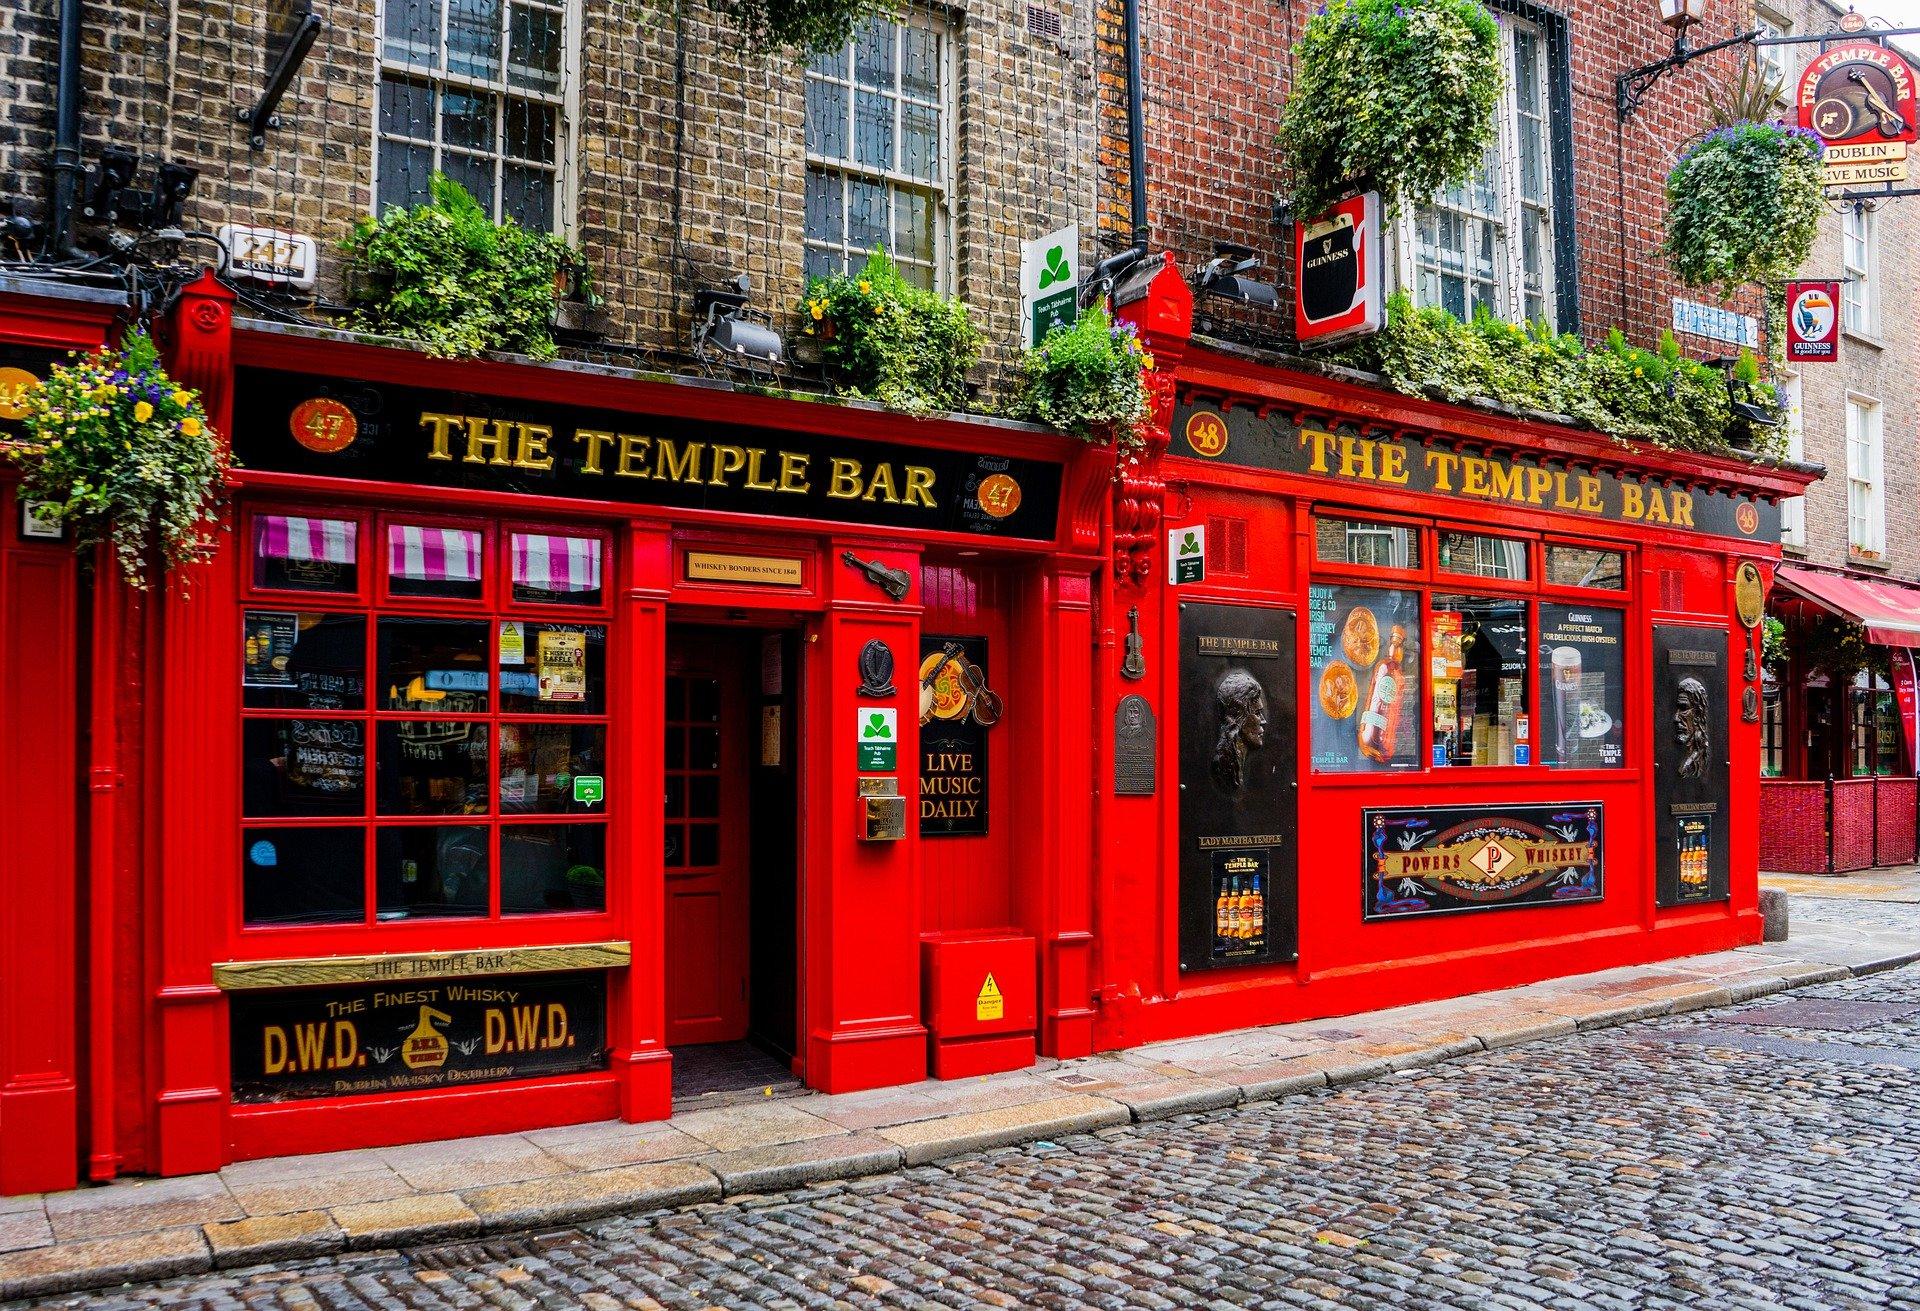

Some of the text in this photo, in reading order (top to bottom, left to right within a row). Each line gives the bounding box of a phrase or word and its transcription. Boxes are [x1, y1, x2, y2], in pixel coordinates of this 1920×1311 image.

[1802, 49, 1910, 107] THE TEMPLE BAR
[1829, 145, 1887, 159] DUBLIN
[1855, 166, 1899, 179] MUSIC
[1307, 249, 1349, 268] GUINNESS
[1794, 342, 1831, 350] GUINNESS
[305, 412, 343, 440] 47
[1193, 421, 1220, 450] 48
[421, 411, 938, 509] THE TEMPLE BAR
[1300, 430, 1695, 527] THE TEMPLE BAR
[988, 484, 1012, 508] 47
[1742, 510, 1753, 528] 48
[694, 563, 727, 571] WHISKEY
[729, 564, 760, 573] BONDERS
[1309, 587, 1333, 600] ENJOY A
[1321, 601, 1327, 610] &
[1328, 601, 1336, 611] CO
[1568, 612, 1592, 623] GUINNESS
[1563, 624, 1584, 632] PERFECT
[1200, 637, 1278, 650] THE TEMPLE BAR
[1317, 634, 1328, 645] THE
[1555, 633, 1581, 642] DELICIOUS
[1582, 635, 1595, 643] IRISH
[1596, 636, 1617, 644] OYSTERS
[1310, 644, 1332, 657] TEMPLE
[1310, 656, 1322, 668] BAR
[1312, 756, 1335, 764] TEMPLE
[1599, 749, 1622, 757] TEMPLE
[927, 754, 973, 771] LIVE
[920, 777, 980, 794] MUSIC
[920, 800, 979, 818] DAILY
[1200, 835, 1281, 846] LADY MARTHA TEMPLE
[1402, 846, 1582, 873] POWERS P WHISKEY
[373, 955, 505, 975] THE TEMPLE BAR
[325, 985, 520, 1018] THE FINEST WHISKY
[485, 1003, 575, 1054] D.W.D.
[264, 1020, 366, 1073] D.W.D.
[334, 1066, 515, 1091] DUBLIN WHISKY DISTILLERY
